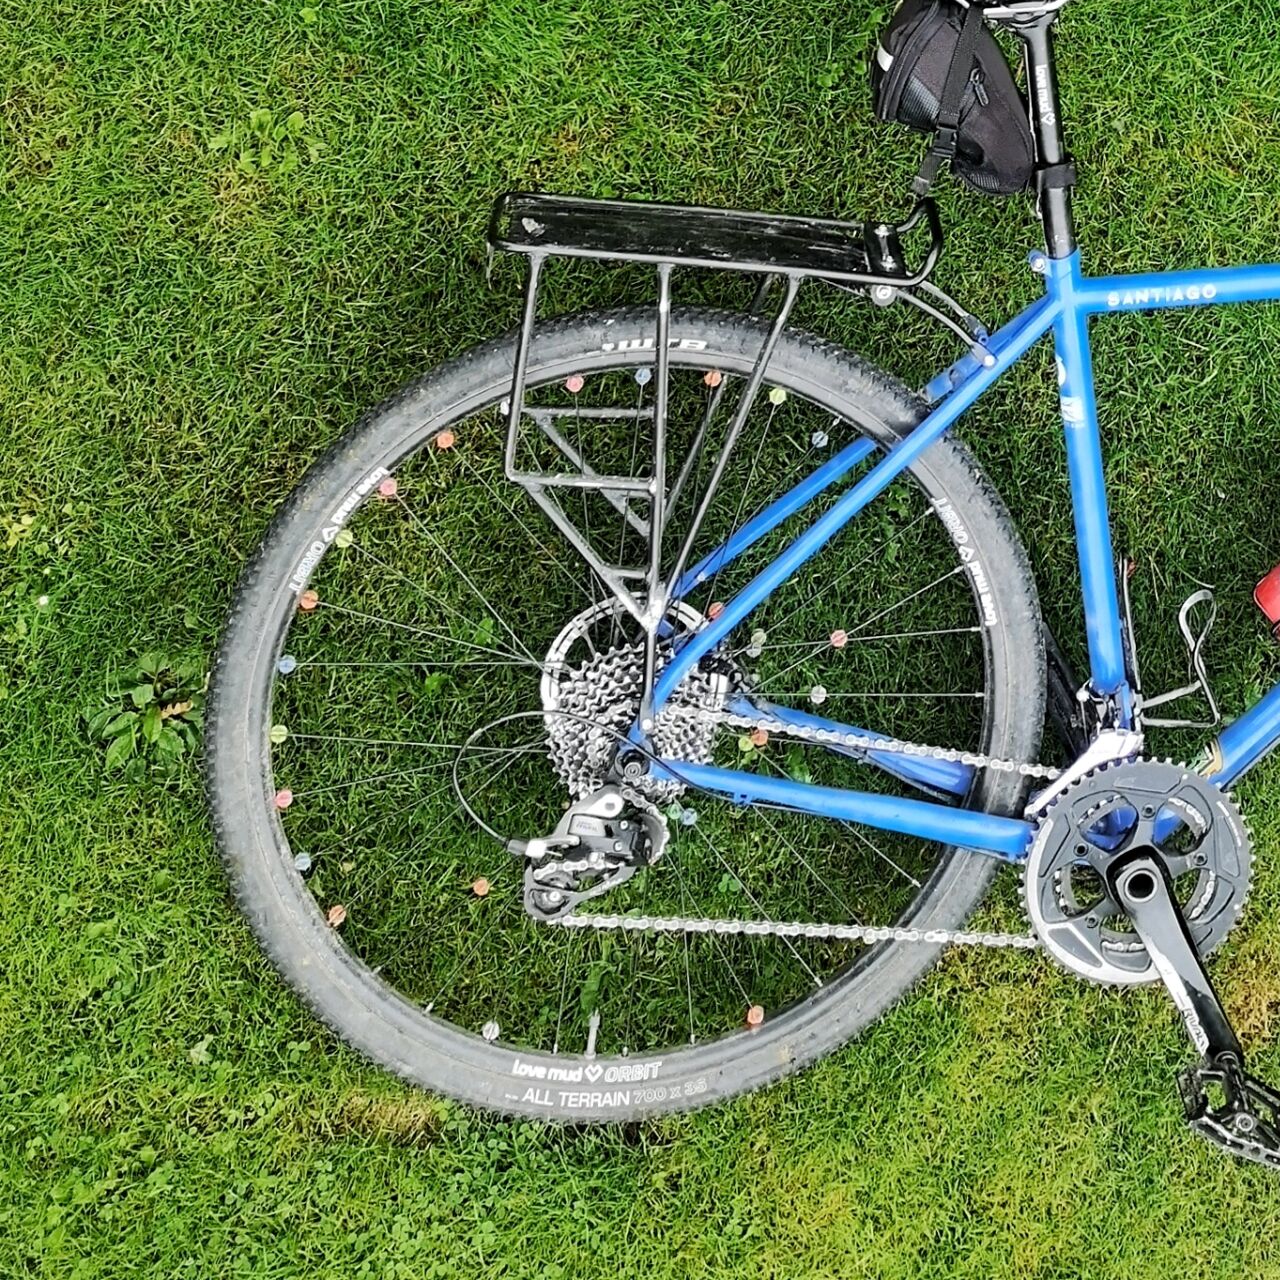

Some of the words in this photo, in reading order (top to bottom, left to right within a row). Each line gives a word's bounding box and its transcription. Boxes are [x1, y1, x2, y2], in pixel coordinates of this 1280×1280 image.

[1037, 88, 1053, 114] mud
[1107, 283, 1217, 307] SANTIAGO
[930, 497, 969, 545] ORBIT
[288, 540, 326, 595] ORBIT
[512, 1058, 547, 1079] love
[547, 1066, 584, 1083] mud
[603, 1060, 663, 1084] ORBIT
[521, 1086, 554, 1107] ALL
[557, 1090, 631, 1109] TERRAIN
[632, 1088, 667, 1105] 700
